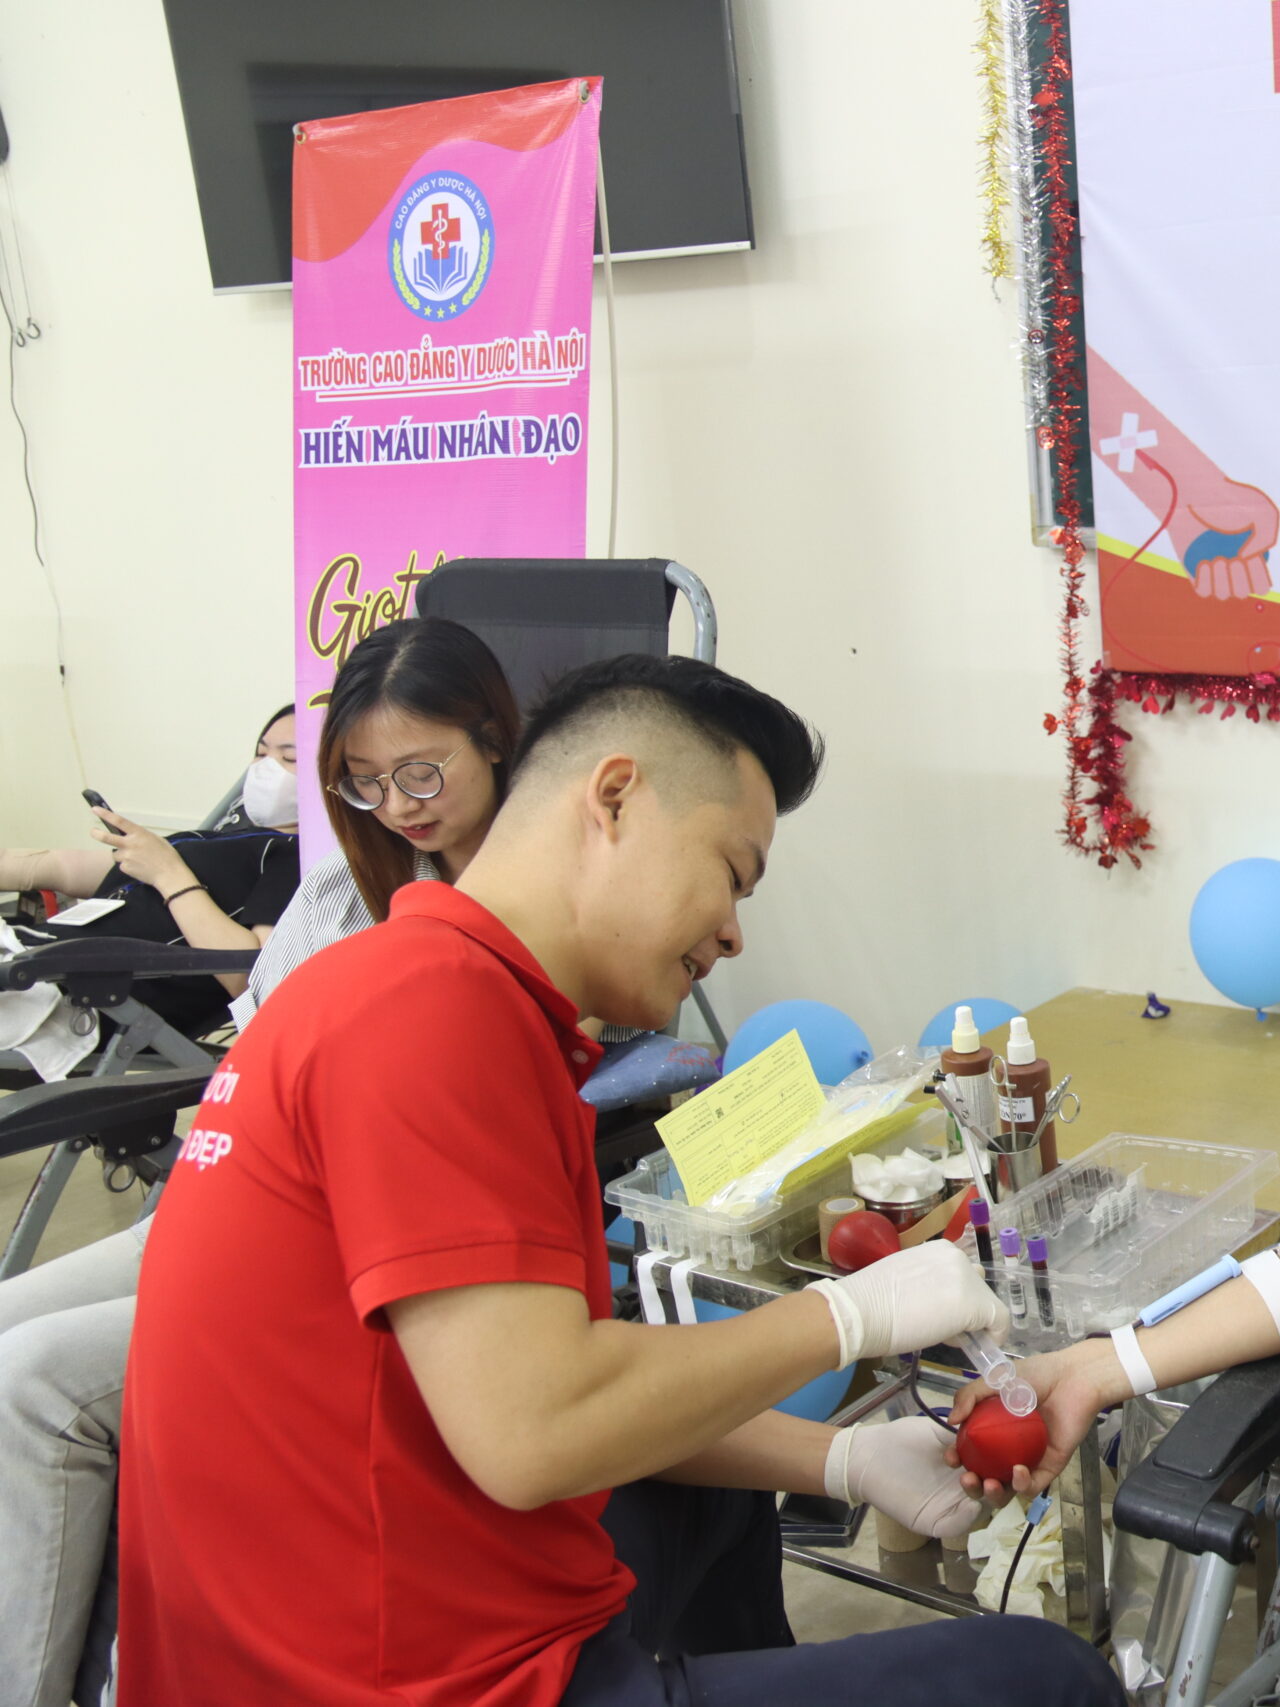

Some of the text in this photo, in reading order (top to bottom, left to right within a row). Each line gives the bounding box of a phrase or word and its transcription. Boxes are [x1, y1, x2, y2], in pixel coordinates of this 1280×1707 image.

[394, 205, 409, 230] CAO
[300, 331, 584, 388] TRƯỜNG CAO ĐẲNG Y DƯỢC HÀ NỘI
[302, 412, 580, 465] HIẾN MÁU NHÂN ĐẠO
[185, 1129, 233, 1172] ĐẸP
